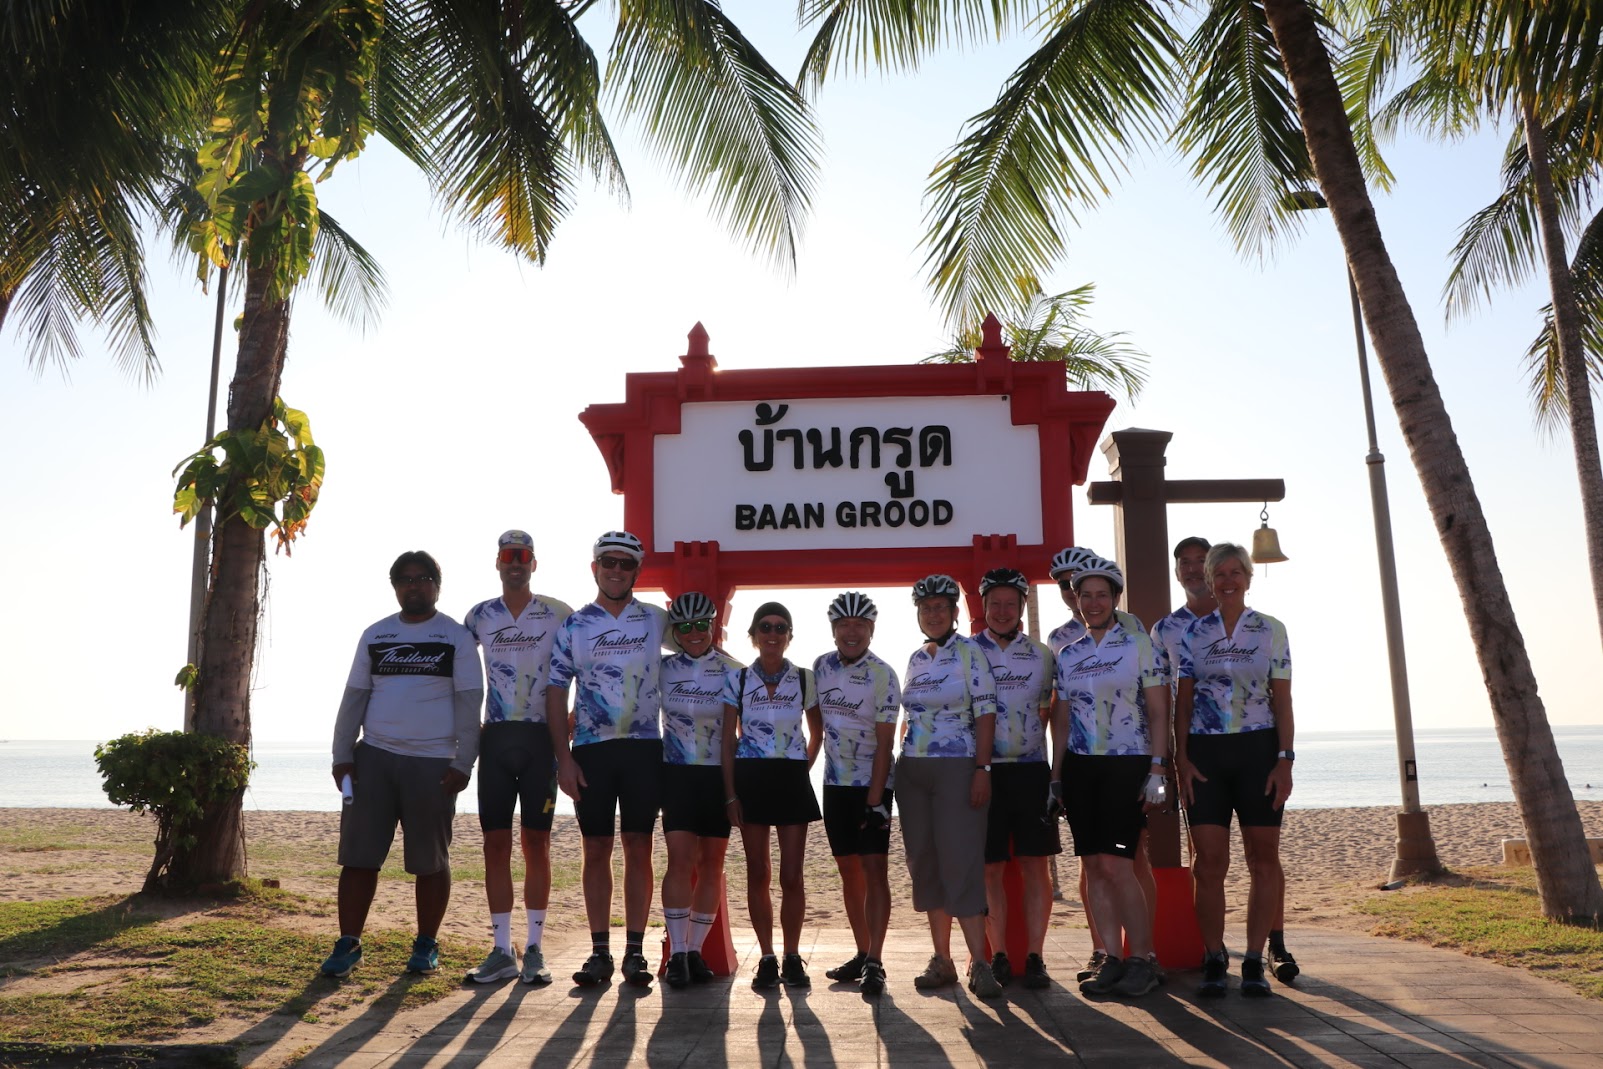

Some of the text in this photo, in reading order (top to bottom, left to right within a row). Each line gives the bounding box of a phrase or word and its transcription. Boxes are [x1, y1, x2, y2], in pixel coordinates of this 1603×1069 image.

[738, 402, 952, 499] บ้านกรูด
[735, 500, 954, 531] BAAN GROOD
[487, 626, 547, 648] Thailand
[587, 629, 649, 652] Thailand
[376, 644, 446, 667] Thailand
[1201, 636, 1259, 663] Thailand
[993, 665, 1033, 682] ailand
[1068, 654, 1123, 677] Thailand
[667, 680, 723, 697] Thailand
[908, 672, 949, 688] Thailand
[819, 687, 864, 710] Thailand
